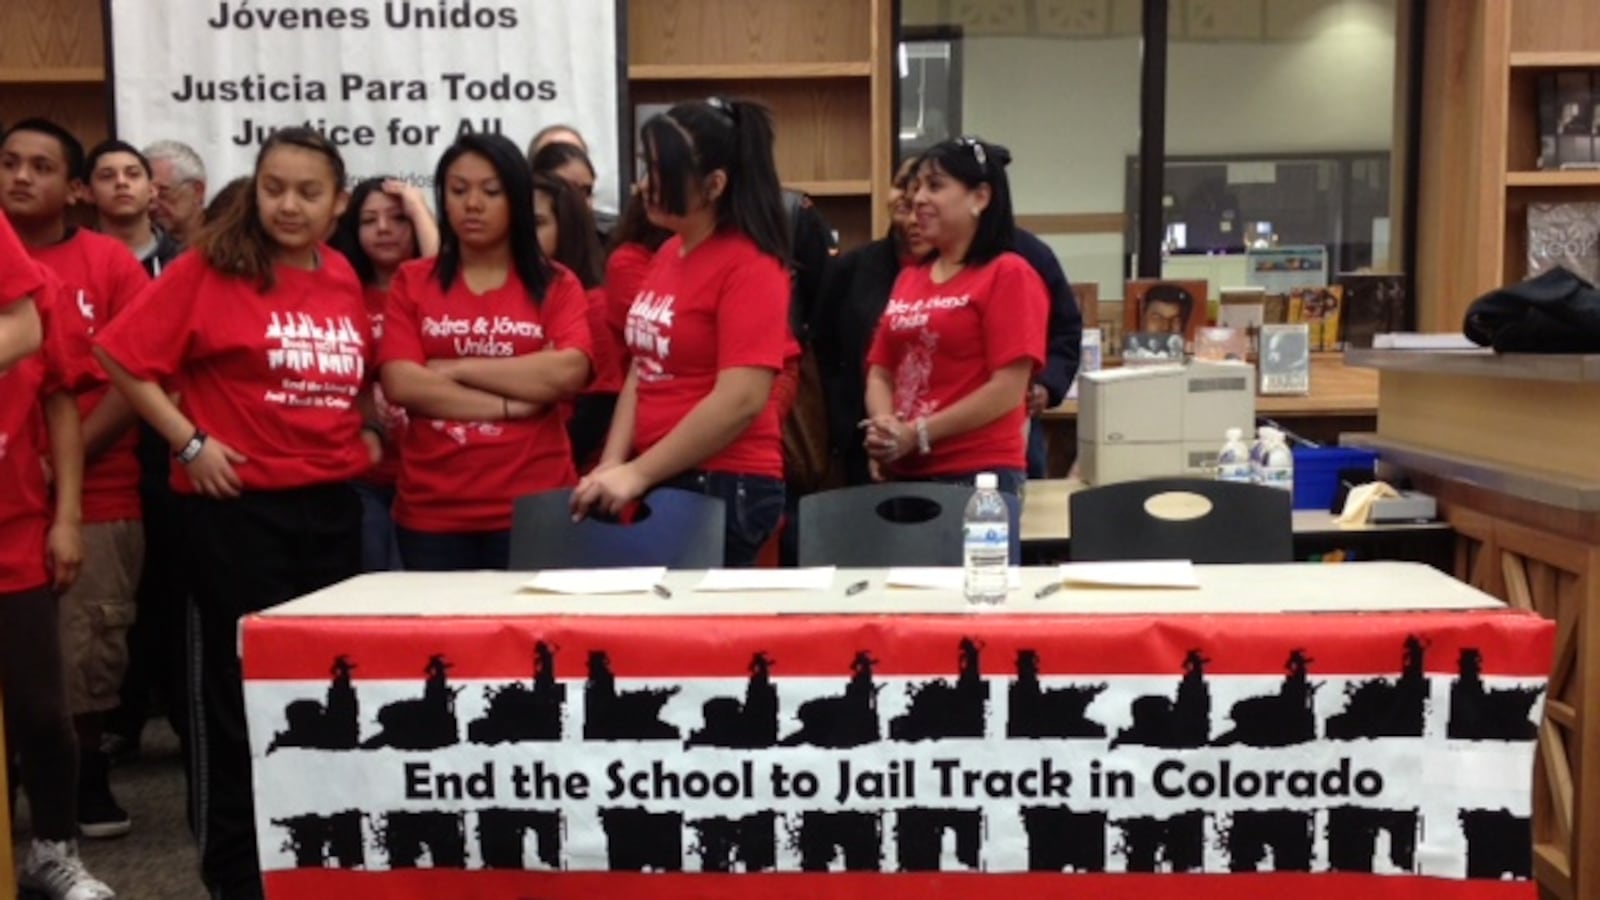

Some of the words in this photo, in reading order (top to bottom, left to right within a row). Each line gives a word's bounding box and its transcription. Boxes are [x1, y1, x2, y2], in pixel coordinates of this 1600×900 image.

[208, 0, 371, 30] Jóvenes
[385, 0, 518, 29] Unidos
[171, 73, 327, 102] Justicia
[341, 73, 427, 102] Para
[441, 72, 557, 102] Todos
[387, 117, 440, 146] for
[471, 316, 488, 335] &
[453, 335, 514, 356] Unidos
[404, 760, 496, 800] End
[511, 760, 591, 800] the
[606, 759, 755, 800] School
[770, 762, 820, 799] to
[835, 758, 916, 805] Jail
[931, 757, 1073, 799] Track
[1090, 758, 1134, 799] in
[1152, 756, 1384, 799] Colorado
